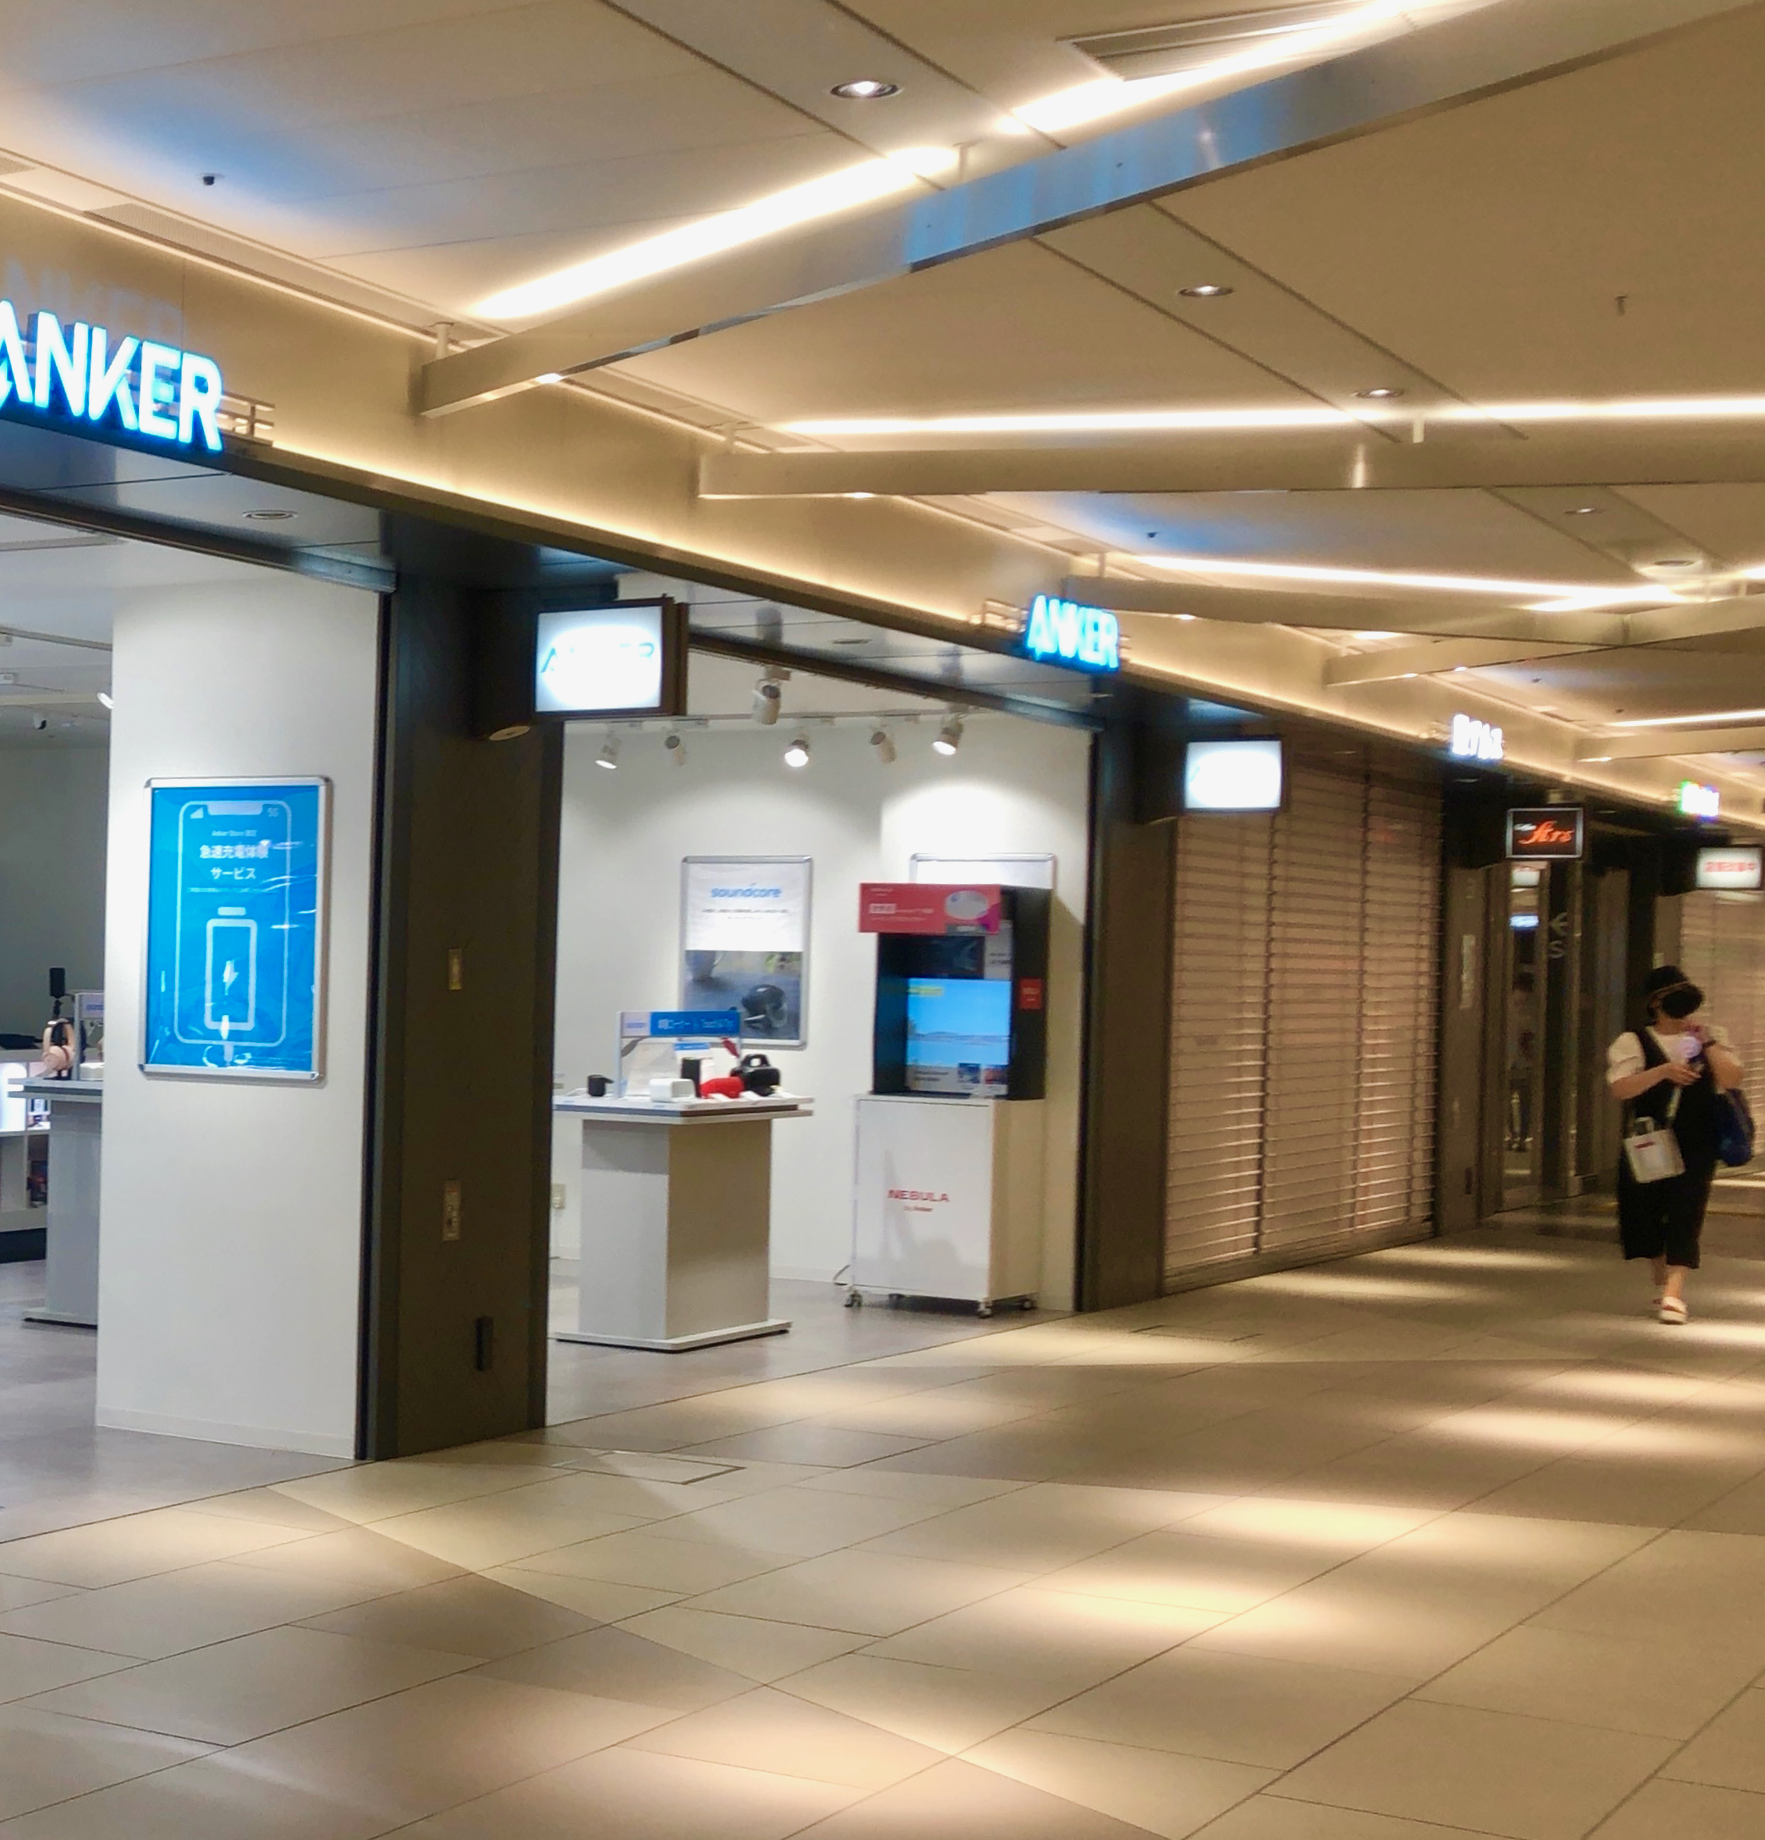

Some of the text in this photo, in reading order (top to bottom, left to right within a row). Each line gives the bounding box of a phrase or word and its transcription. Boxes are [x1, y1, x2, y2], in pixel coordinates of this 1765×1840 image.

[1026, 594, 1119, 669] ANKER
[210, 866, 257, 880] サービス
[710, 883, 782, 898] soundcore
[887, 1189, 950, 1202] NEBULA
